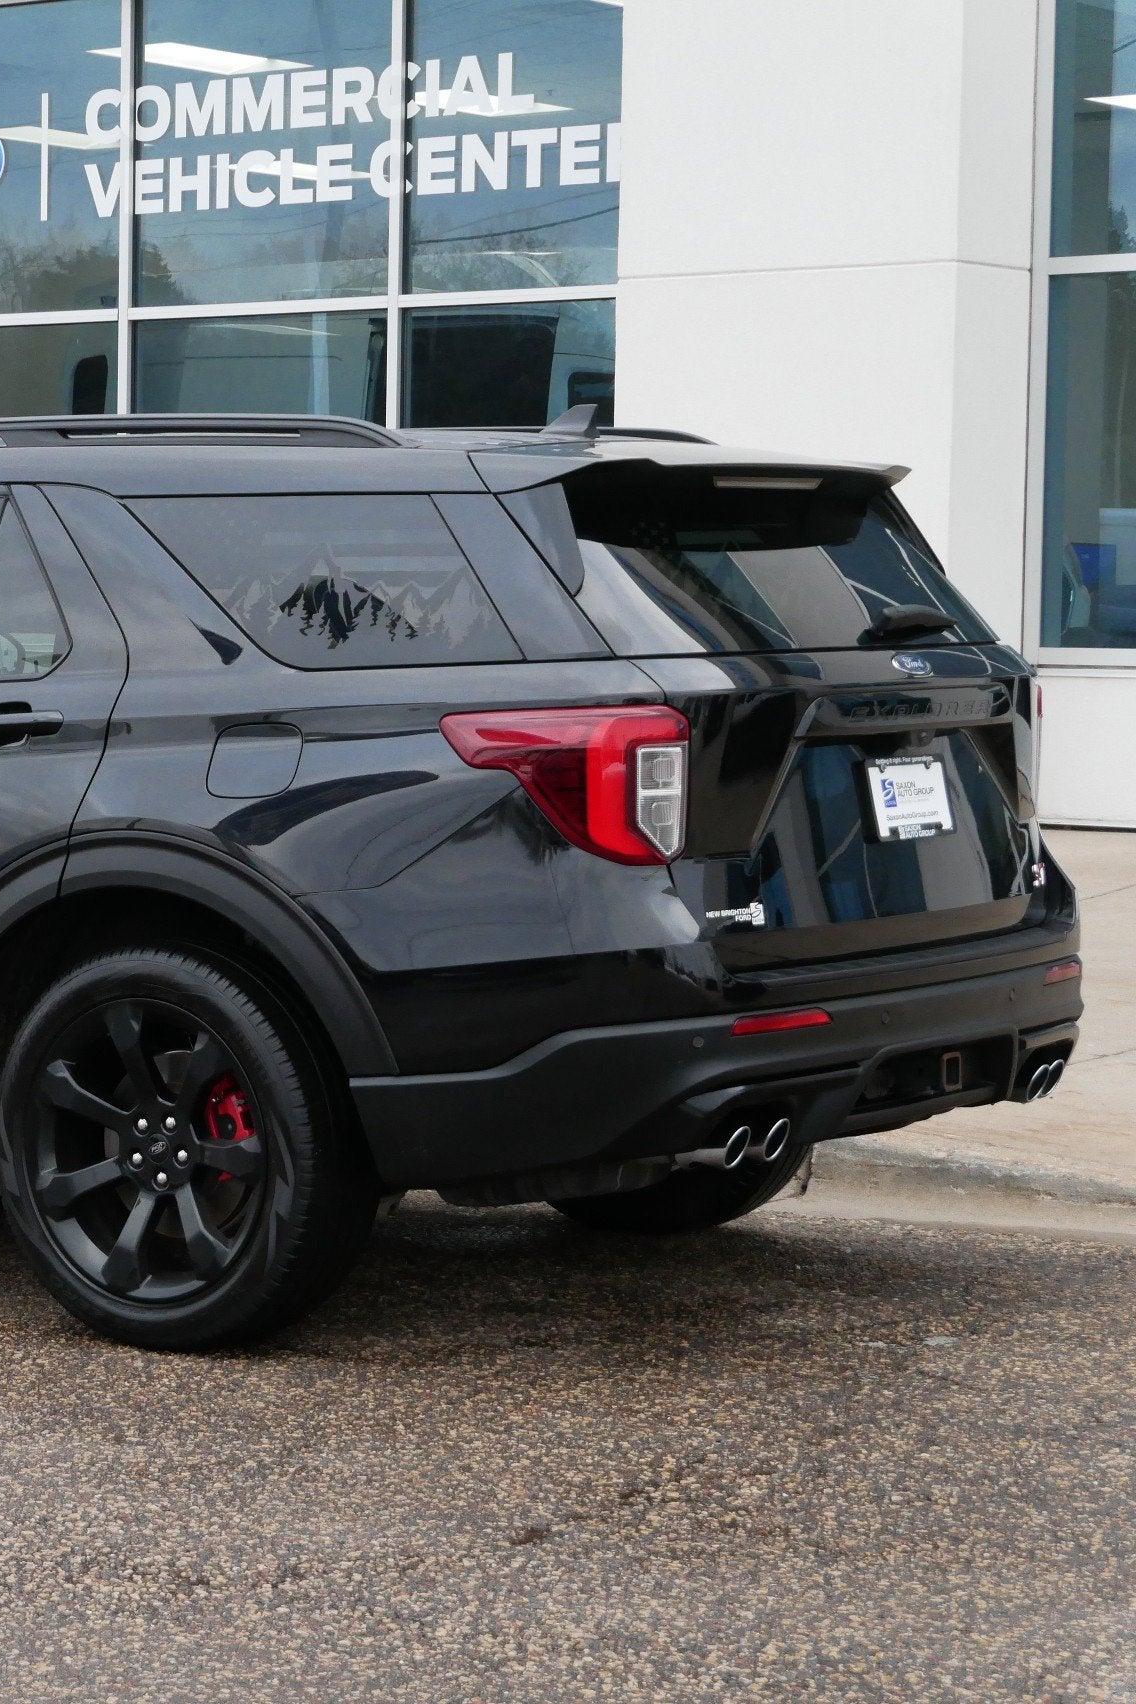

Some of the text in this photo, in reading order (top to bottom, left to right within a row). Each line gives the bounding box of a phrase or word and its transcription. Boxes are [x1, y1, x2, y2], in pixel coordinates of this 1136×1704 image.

[85, 52, 535, 142] COMMERCIAL
[84, 143, 354, 218] VEHICLE
[849, 702, 990, 723] EXPLORER
[897, 787, 934, 797] AUTO GROUP
